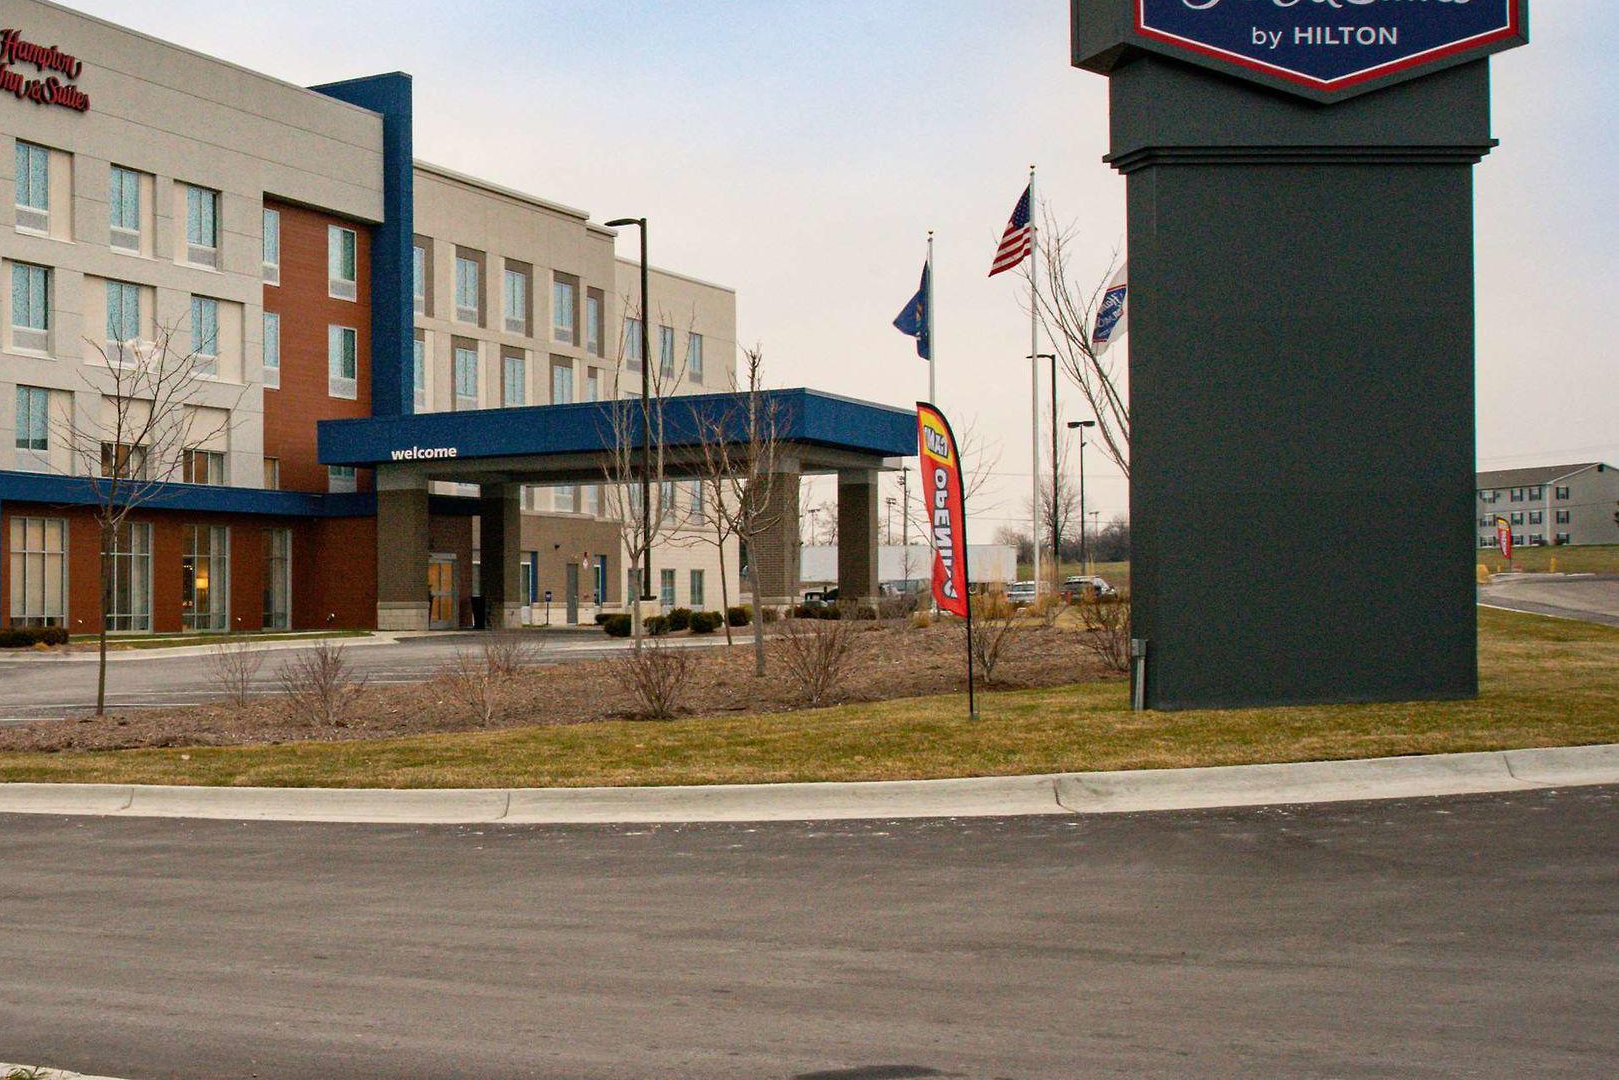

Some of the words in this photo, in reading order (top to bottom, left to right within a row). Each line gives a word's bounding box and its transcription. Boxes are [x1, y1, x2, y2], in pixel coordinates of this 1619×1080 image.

[1251, 26, 1282, 50] by
[1293, 26, 1398, 46] HILTON
[41, 76, 91, 113] Suites
[391, 446, 458, 461] welcome
